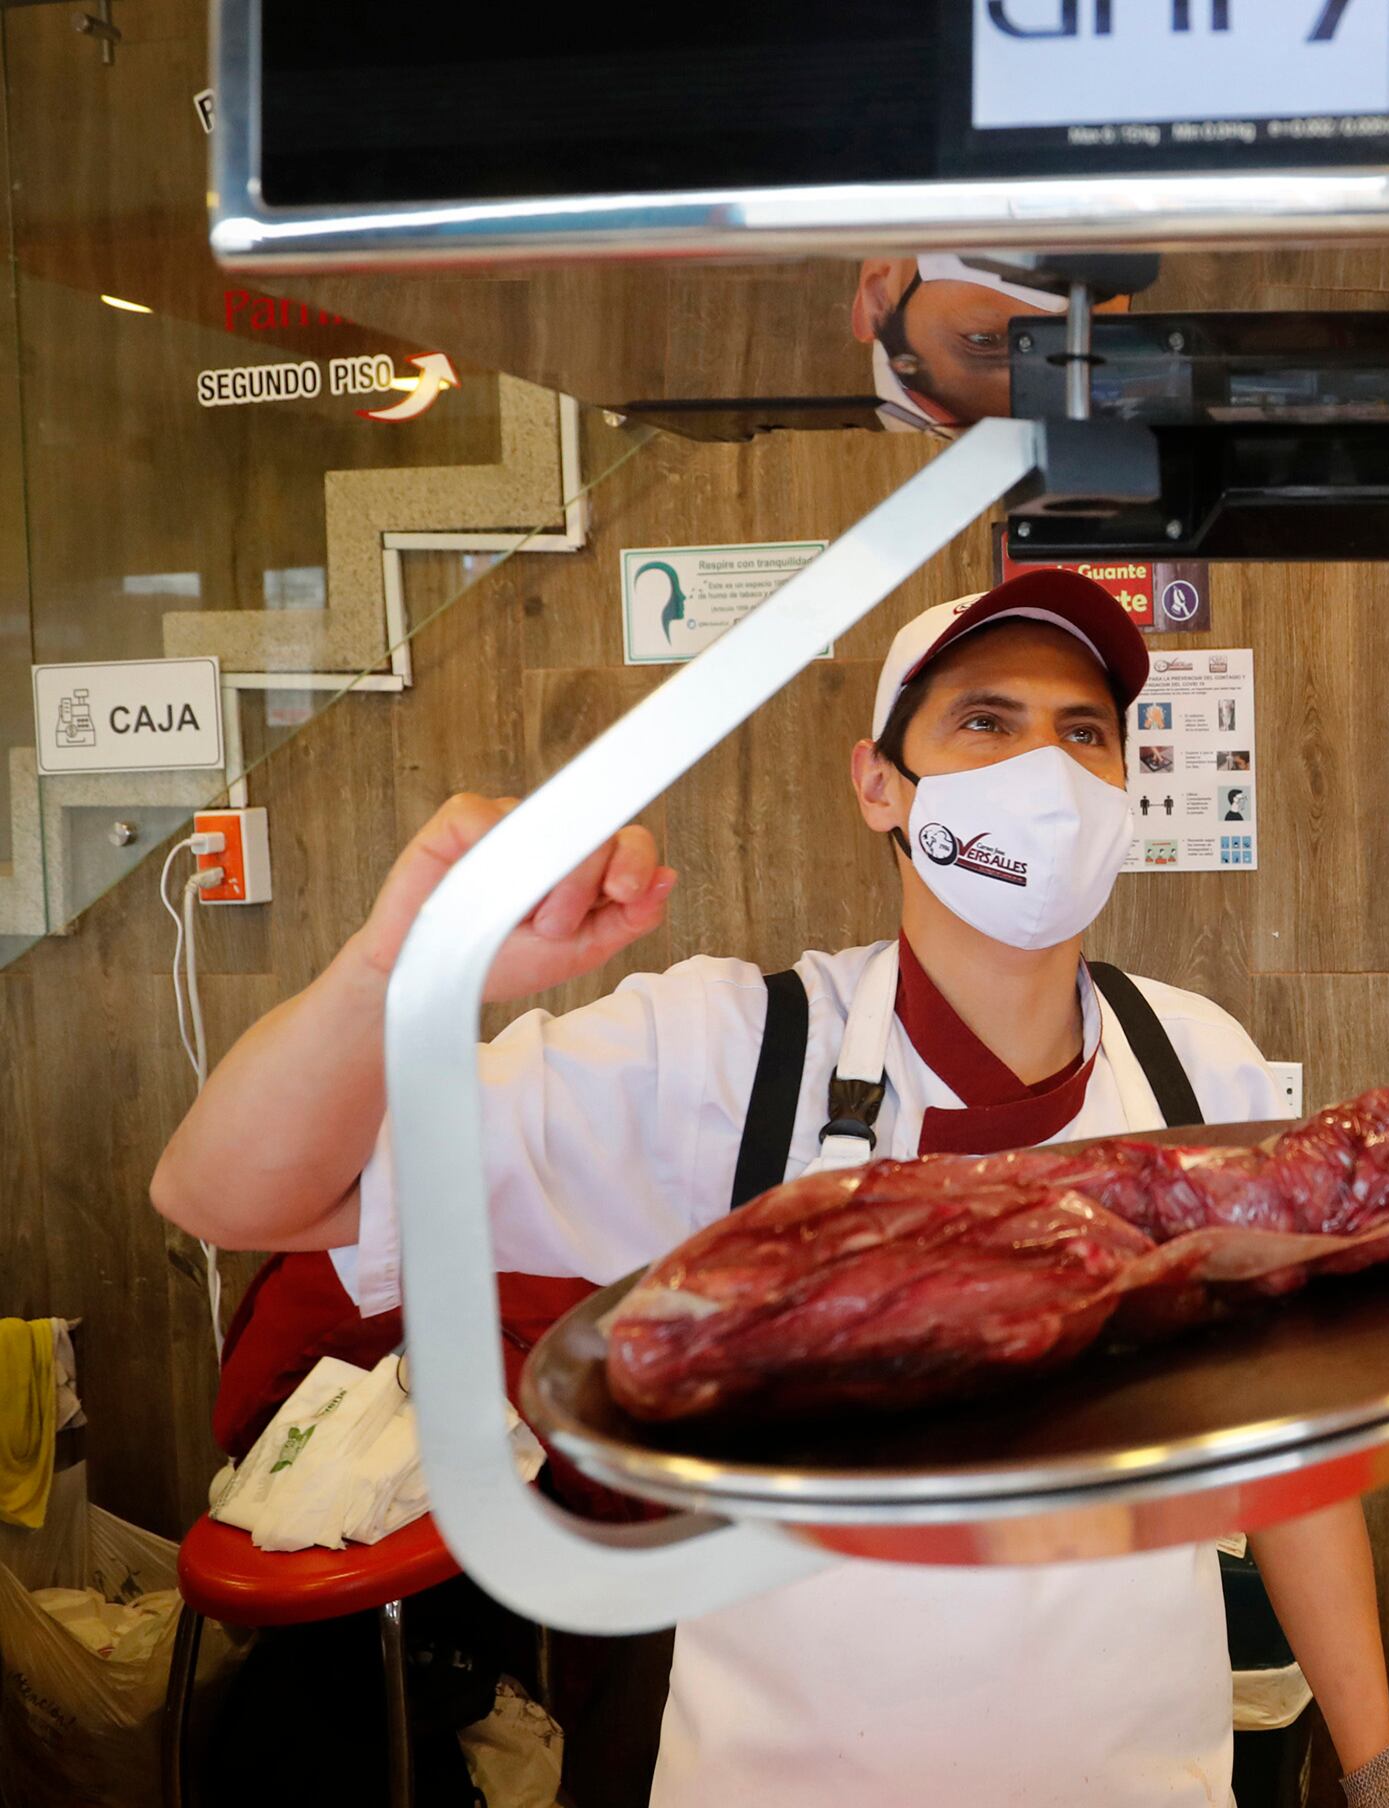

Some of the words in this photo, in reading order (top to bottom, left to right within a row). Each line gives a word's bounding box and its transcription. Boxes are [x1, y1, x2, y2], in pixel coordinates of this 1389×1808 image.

[199, 365, 319, 402] SEGUNDO
[333, 360, 393, 391] PISO
[699, 559, 735, 573] Respire
[737, 560, 754, 569] con
[1078, 563, 1148, 580] Guante
[109, 703, 200, 734] CAJA
[956, 832, 1028, 874] VERSALLES
